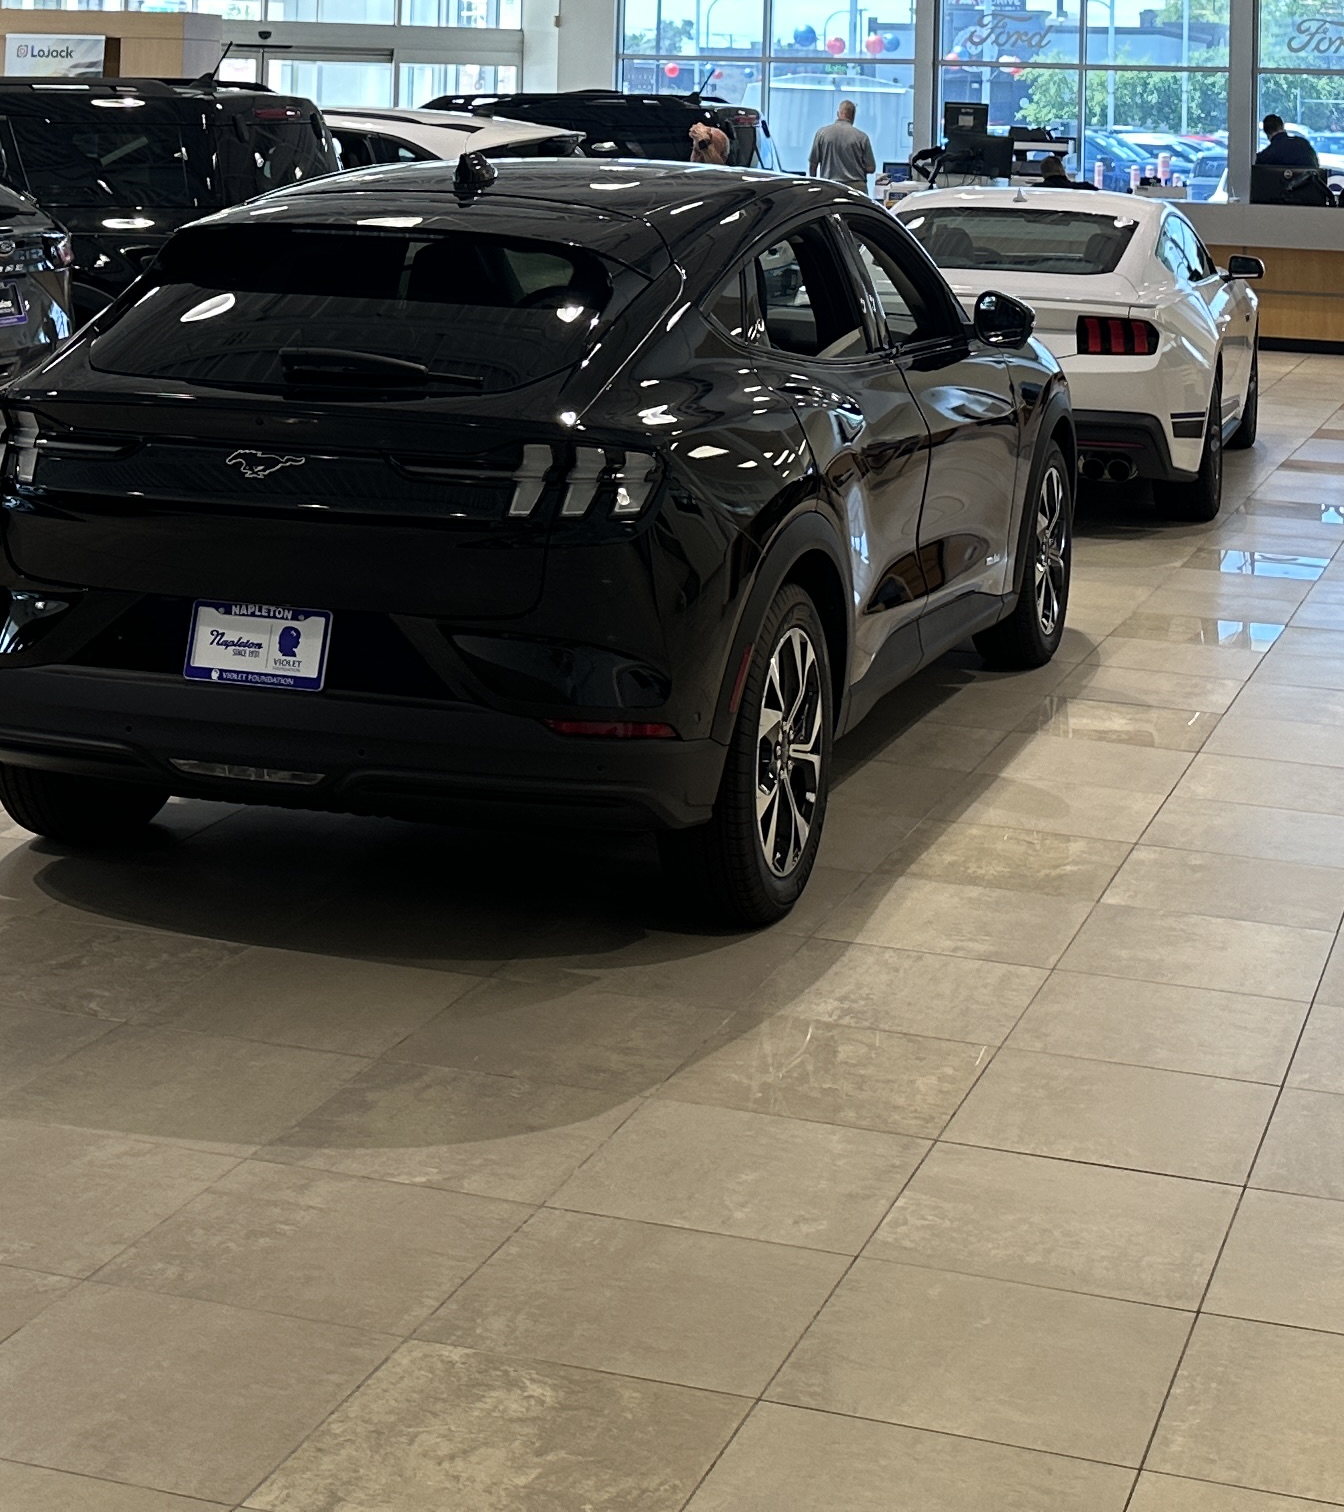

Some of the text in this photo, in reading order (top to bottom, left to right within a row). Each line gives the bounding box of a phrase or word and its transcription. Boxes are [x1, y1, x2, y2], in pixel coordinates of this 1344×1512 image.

[968, 14, 1054, 49] Ford
[231, 604, 293, 620] NAPLETON
[209, 629, 264, 650] Napleton
[232, 648, 247, 658] SINCE
[273, 657, 303, 668] VIOLET
[222, 671, 295, 685] VIOLET FOUNDATION
